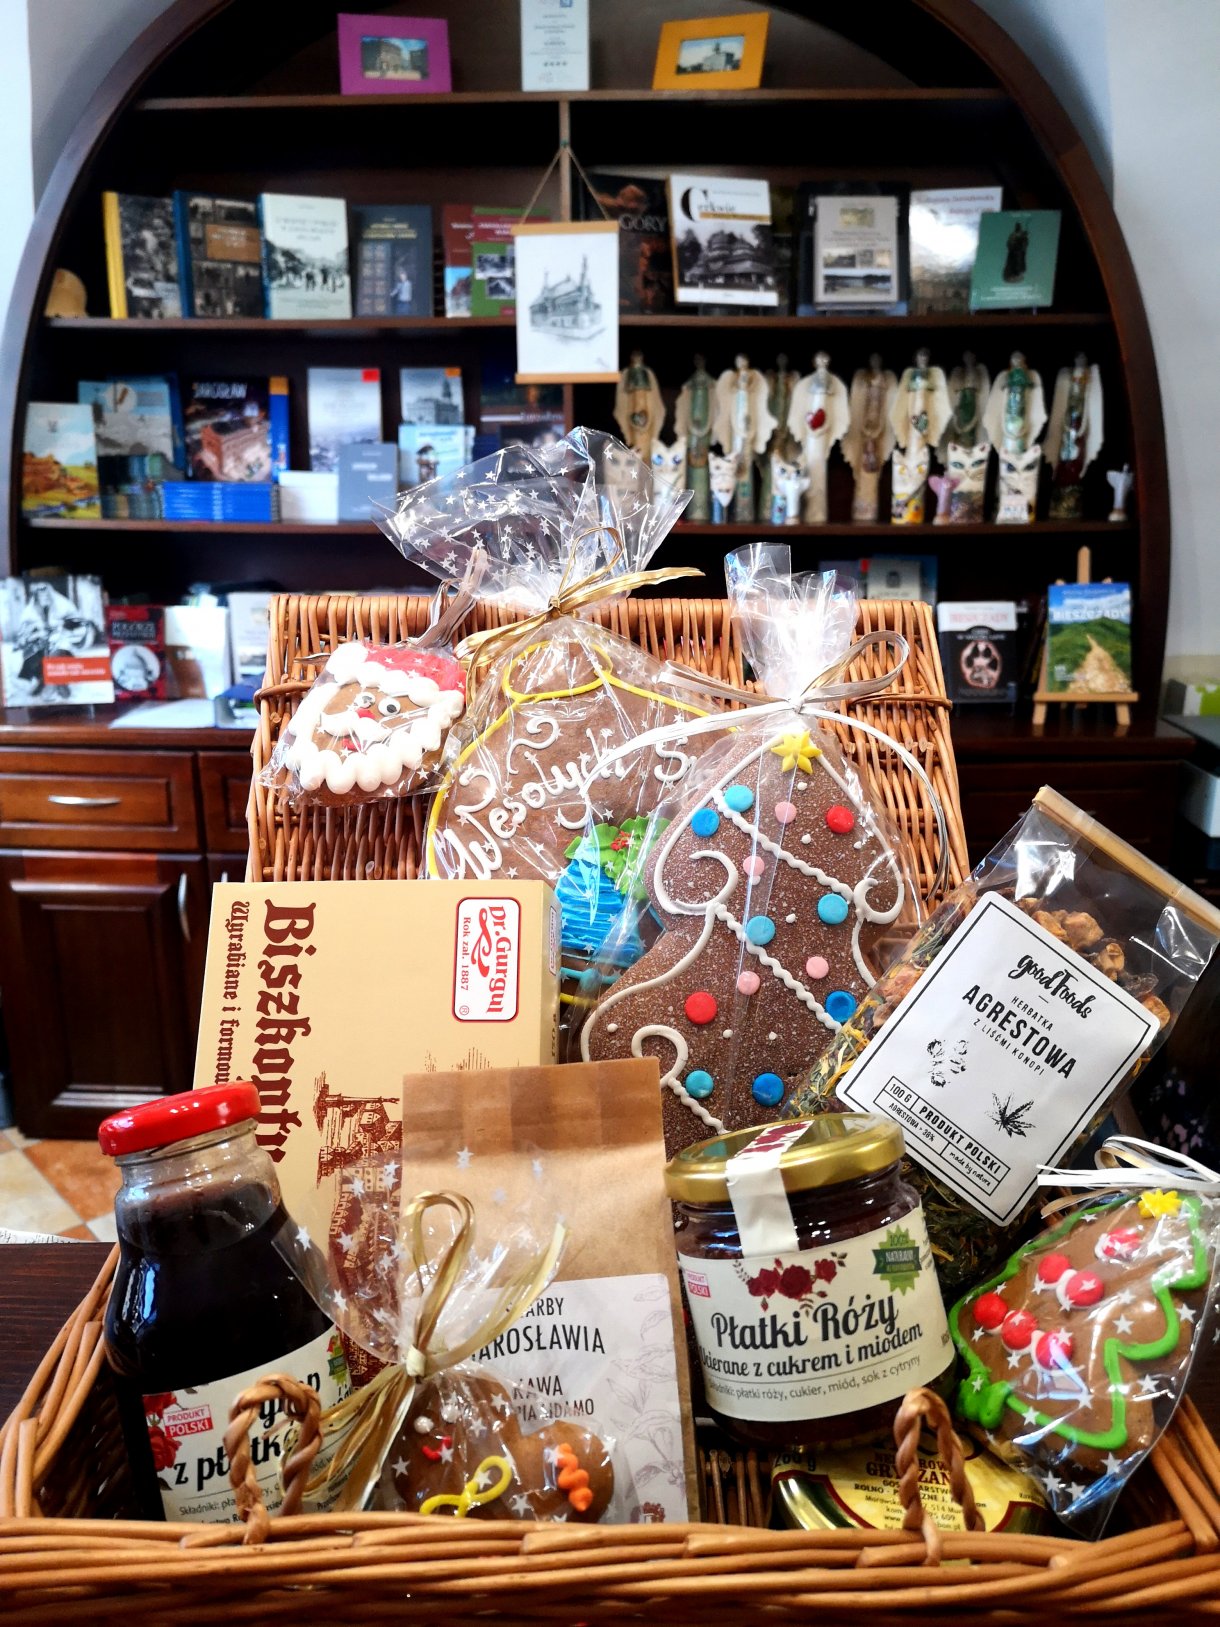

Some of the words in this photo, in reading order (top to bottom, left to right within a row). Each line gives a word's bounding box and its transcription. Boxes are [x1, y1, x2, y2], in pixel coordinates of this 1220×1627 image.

[463, 917, 471, 937] Rok
[460, 964, 469, 991] 1887
[1011, 996, 1054, 1031] HERBATKA
[962, 984, 1077, 1079] AGRESTOWA
[981, 1024, 1011, 1050] LIŚĆMI
[1011, 1047, 1045, 1076] KONOPI
[889, 1083, 905, 1099] 100
[905, 1093, 912, 1104] G
[919, 1105, 964, 1145] PRODUKT
[964, 1141, 1001, 1174] POLSKI
[949, 1152, 965, 1166] made
[964, 1163, 973, 1175] by
[522, 1297, 564, 1318] ARBY
[711, 1310, 808, 1350] Płatki
[812, 1293, 899, 1342] Róży
[753, 1362, 763, 1377] z
[767, 1355, 842, 1376] cukrem
[844, 1344, 854, 1364] i
[858, 1322, 923, 1363] miodem
[736, 1386, 760, 1400] płatki
[762, 1387, 788, 1401] róży,
[789, 1383, 826, 1399] cukier,
[828, 1376, 861, 1394] miód,
[861, 1370, 880, 1385] sok
[889, 1354, 921, 1377] cytryny
[166, 1408, 205, 1422] PRODUKT
[168, 1420, 210, 1436] POLSKI
[173, 1462, 189, 1485] z
